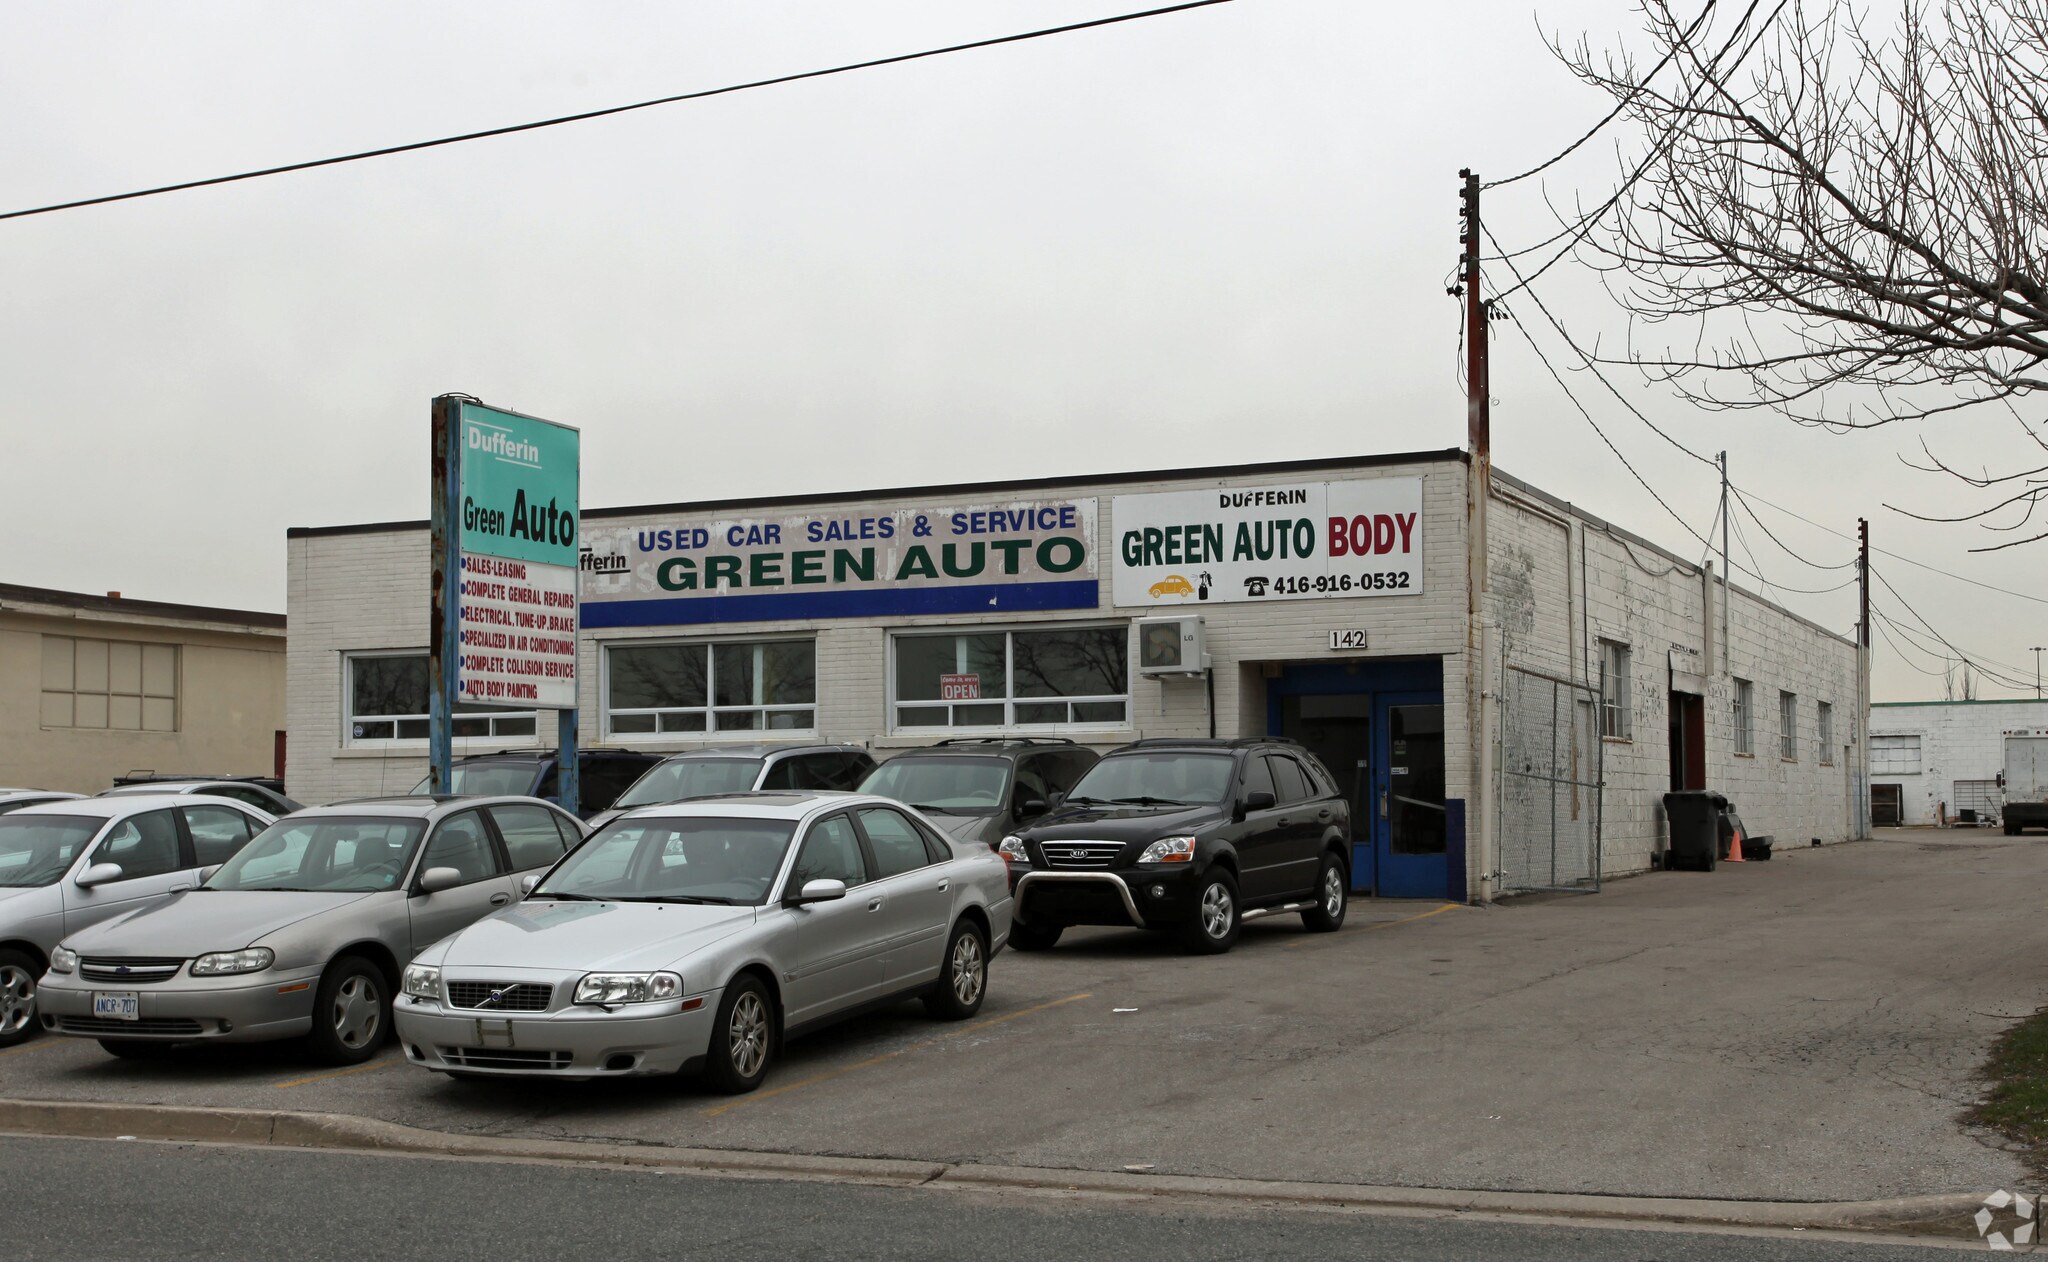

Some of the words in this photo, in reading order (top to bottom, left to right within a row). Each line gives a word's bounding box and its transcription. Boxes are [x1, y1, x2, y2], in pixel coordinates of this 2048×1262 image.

[468, 426, 539, 463] Dufferin
[1220, 489, 1307, 508] DUFFERIN
[464, 496, 505, 536] Green
[509, 488, 575, 547] Auto
[638, 528, 709, 552] USED
[727, 524, 781, 547] CAR
[807, 516, 895, 543] SALES
[912, 515, 933, 537] &
[951, 506, 1076, 535] SERVICE
[1122, 523, 1224, 568] GREEN
[1232, 517, 1316, 562] AUTO
[1328, 512, 1417, 557] BODY
[580, 552, 626, 571] fferin
[656, 547, 875, 592] GREEN
[895, 536, 1085, 581] AUTO
[466, 580, 506, 600] COMPLETE
[508, 586, 542, 606] GENERAL
[543, 591, 574, 609] REPAIRS
[1273, 571, 1410, 595] 416-916-0532
[549, 617, 574, 633] BRAKE
[464, 629, 507, 650] SPECIALIZED
[508, 635, 516, 651] IN
[517, 636, 528, 652] AIR
[529, 638, 574, 656] CONDITIONING
[1183, 634, 1194, 642] LG
[1333, 630, 1365, 647] 142
[465, 654, 504, 673] COMPLETE
[506, 659, 544, 676] COLLISION
[545, 661, 574, 679] SERVICE
[465, 679, 485, 696] AUTO
[486, 682, 505, 697] BODY
[507, 683, 537, 700] PAINTING
[944, 684, 978, 699] OPEN
[121, 999, 136, 1013] 707
